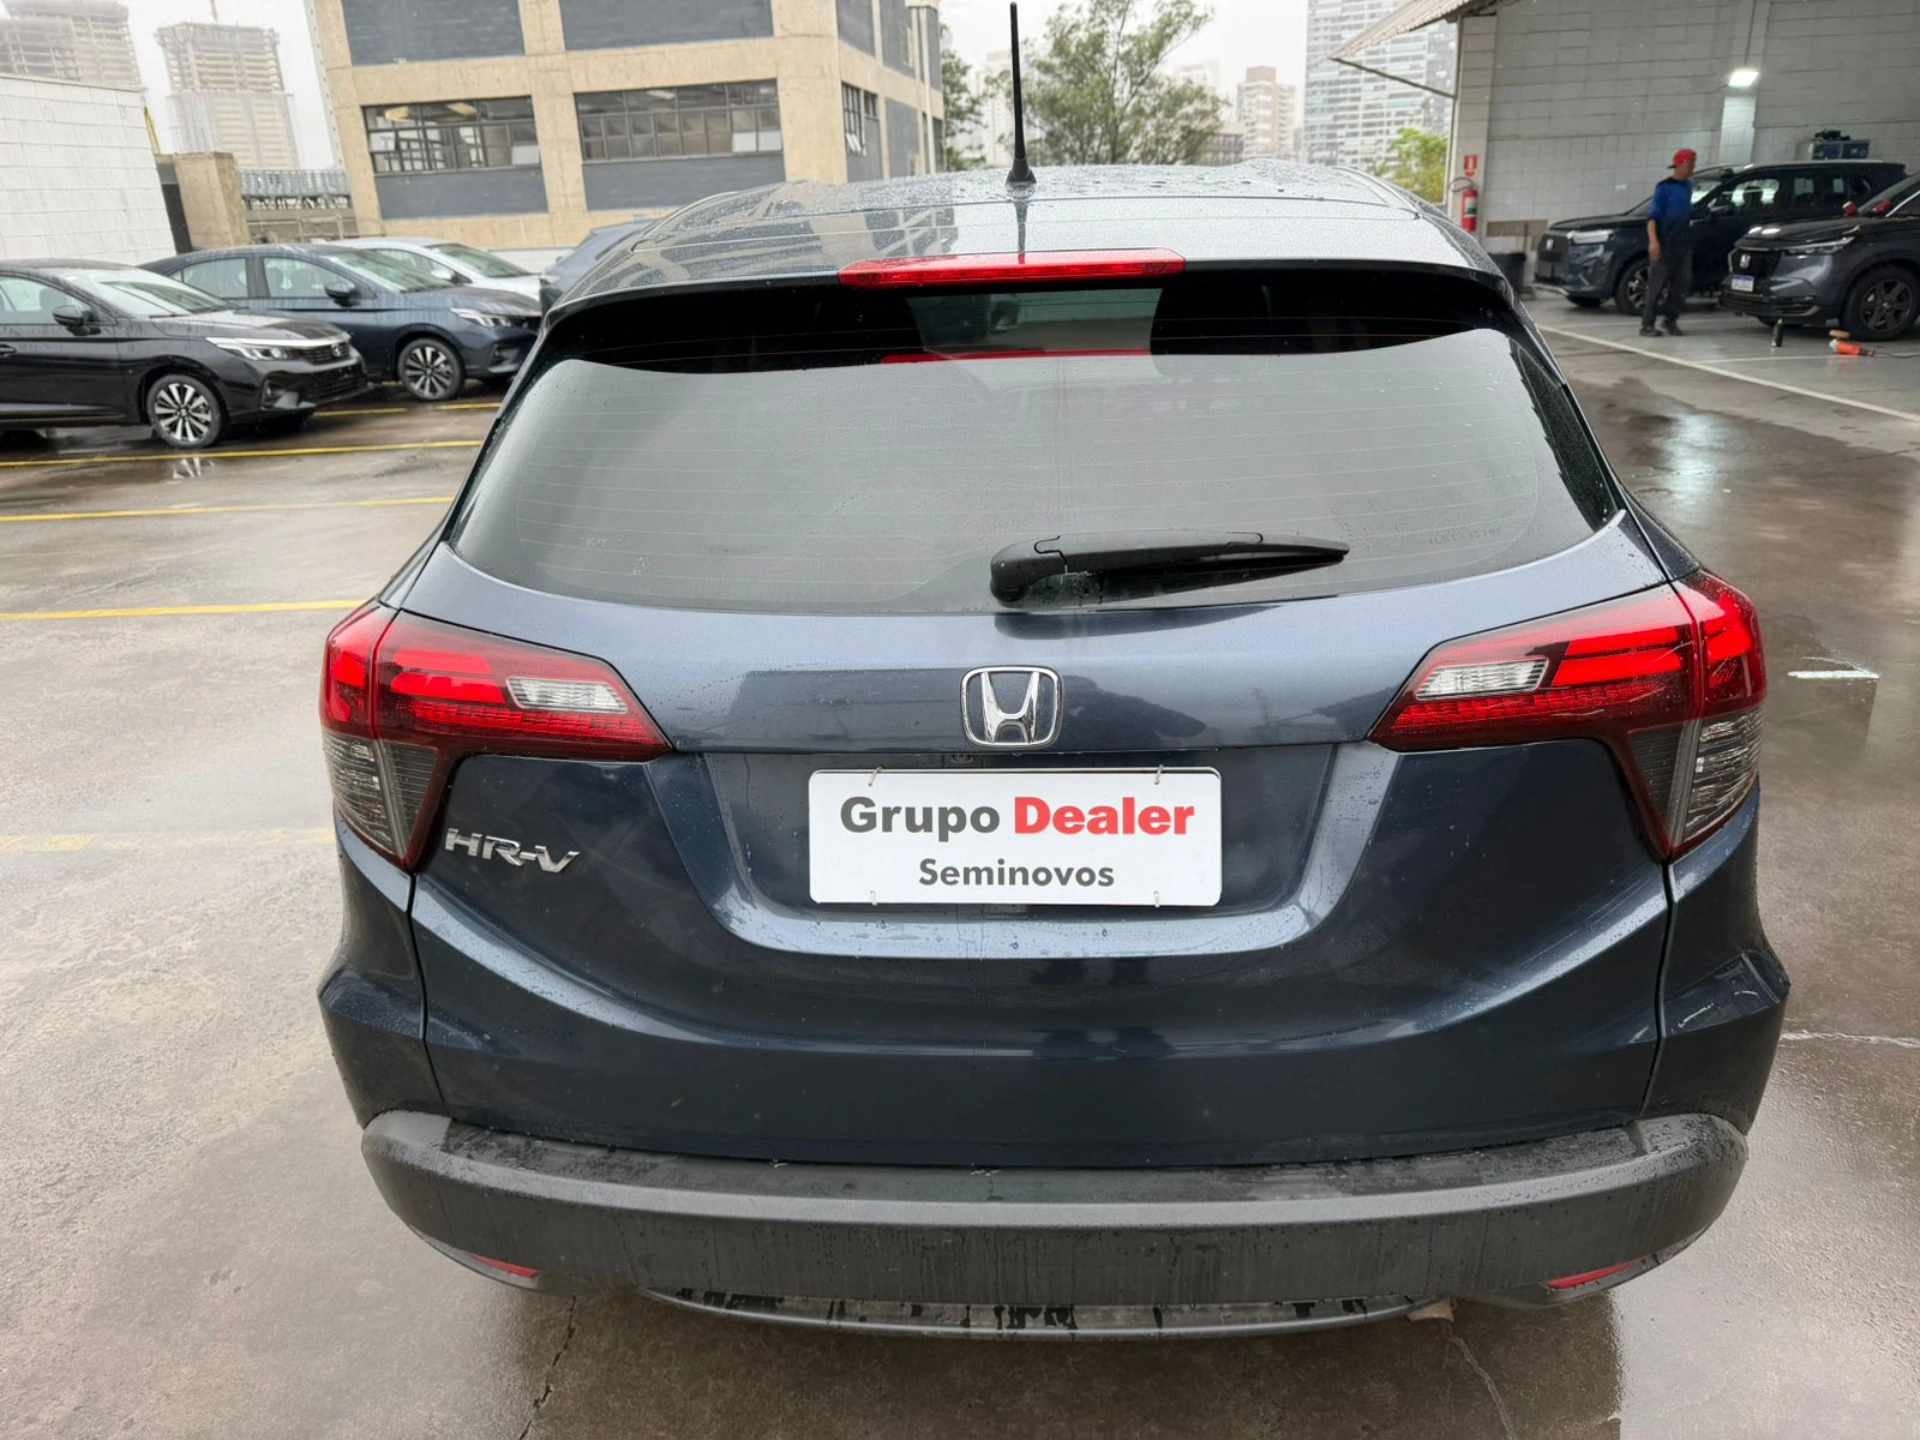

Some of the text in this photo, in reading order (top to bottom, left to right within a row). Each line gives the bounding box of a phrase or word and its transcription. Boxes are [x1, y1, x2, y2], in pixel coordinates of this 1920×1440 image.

[841, 797, 1194, 842] Grupo Dealer
[445, 828, 580, 873] HR-V
[920, 859, 1114, 886] Seminovos
